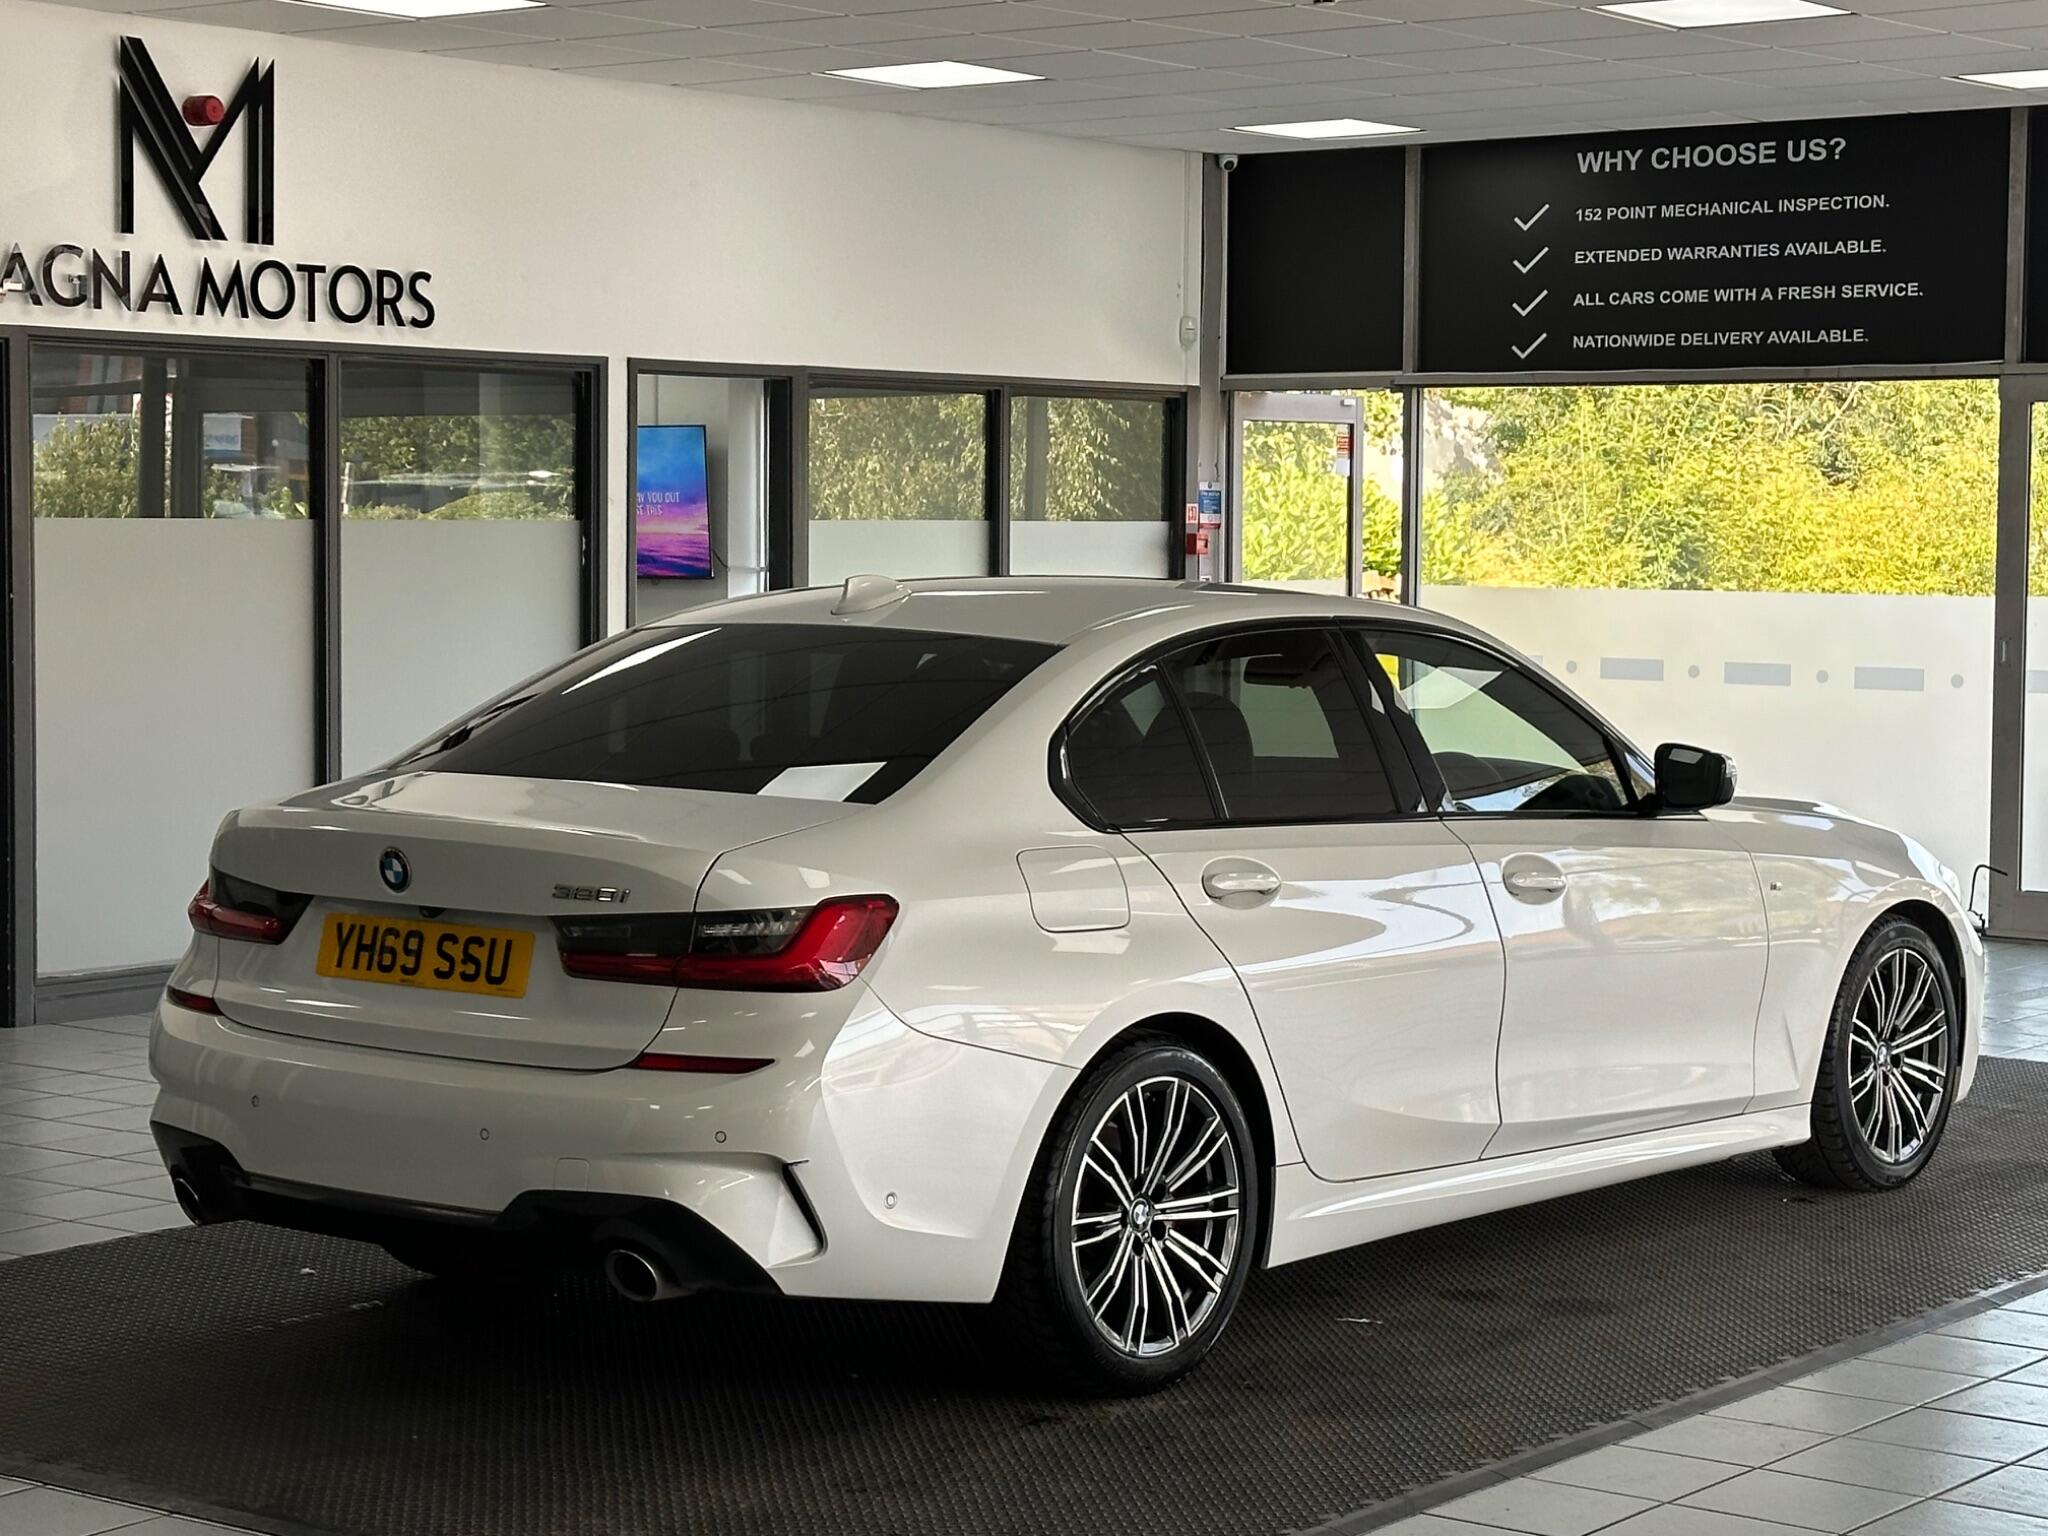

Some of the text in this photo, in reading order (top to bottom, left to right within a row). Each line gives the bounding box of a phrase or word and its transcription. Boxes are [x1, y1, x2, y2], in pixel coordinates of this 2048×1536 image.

[1576, 137, 1847, 174] WHY CHOOSE US?
[1575, 194, 1890, 222] 152 POINT MECHANICAL INSPECTION.
[1574, 239, 1886, 264] EXTENDED WARRANTIES AVAILABLE.
[196, 257, 436, 329] MOTORS
[1572, 282, 1924, 306] ALL CARS COME WITH A FRESH SERVICE.
[1572, 328, 1869, 348] NATIONWIDE DELIVERY AVAILABLE.
[335, 921, 513, 986] YH69 SSU
